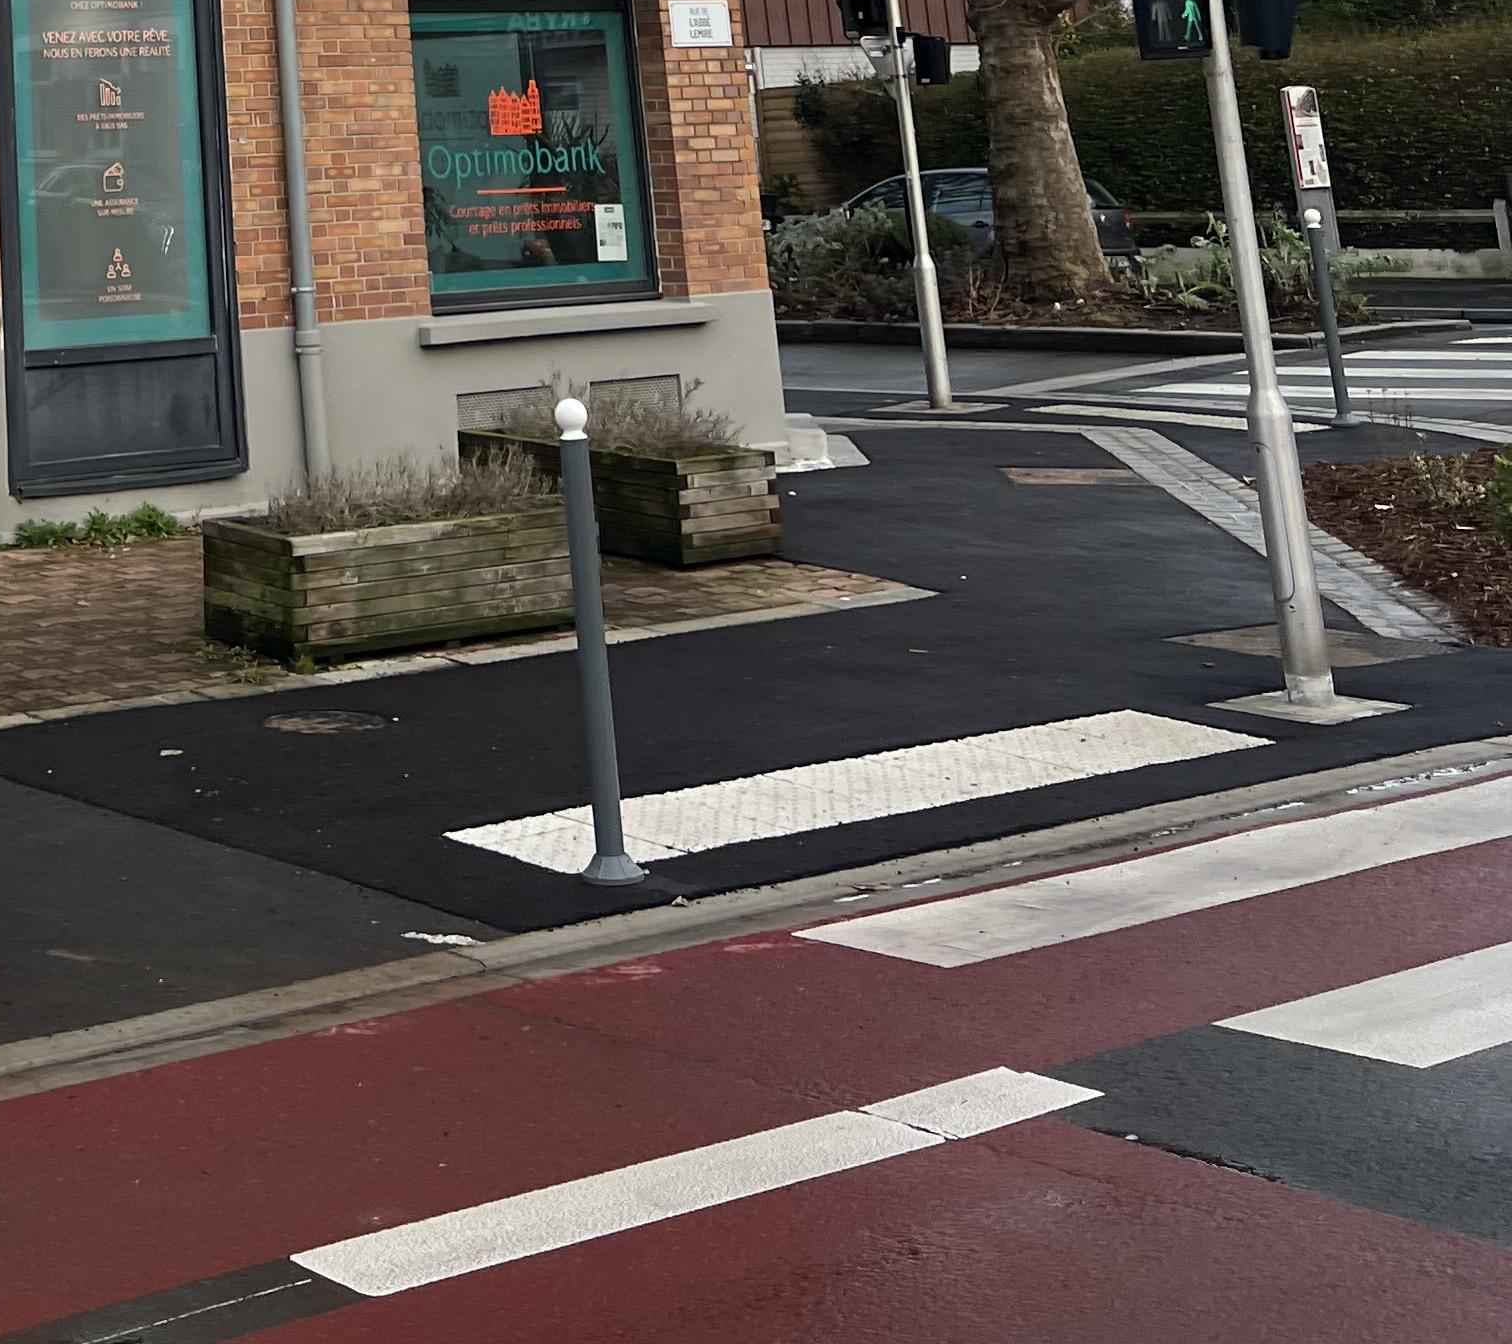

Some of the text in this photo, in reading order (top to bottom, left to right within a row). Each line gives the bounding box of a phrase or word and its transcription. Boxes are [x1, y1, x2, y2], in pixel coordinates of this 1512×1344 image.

[42, 31, 77, 44] VENEZ
[78, 31, 105, 44] AVEC
[106, 29, 142, 43] VOTRE
[43, 48, 69, 59] NOUS
[70, 48, 83, 58] EN
[84, 47, 118, 58] FERONS
[119, 47, 138, 57] UNE
[428, 138, 606, 189] Optimobank
